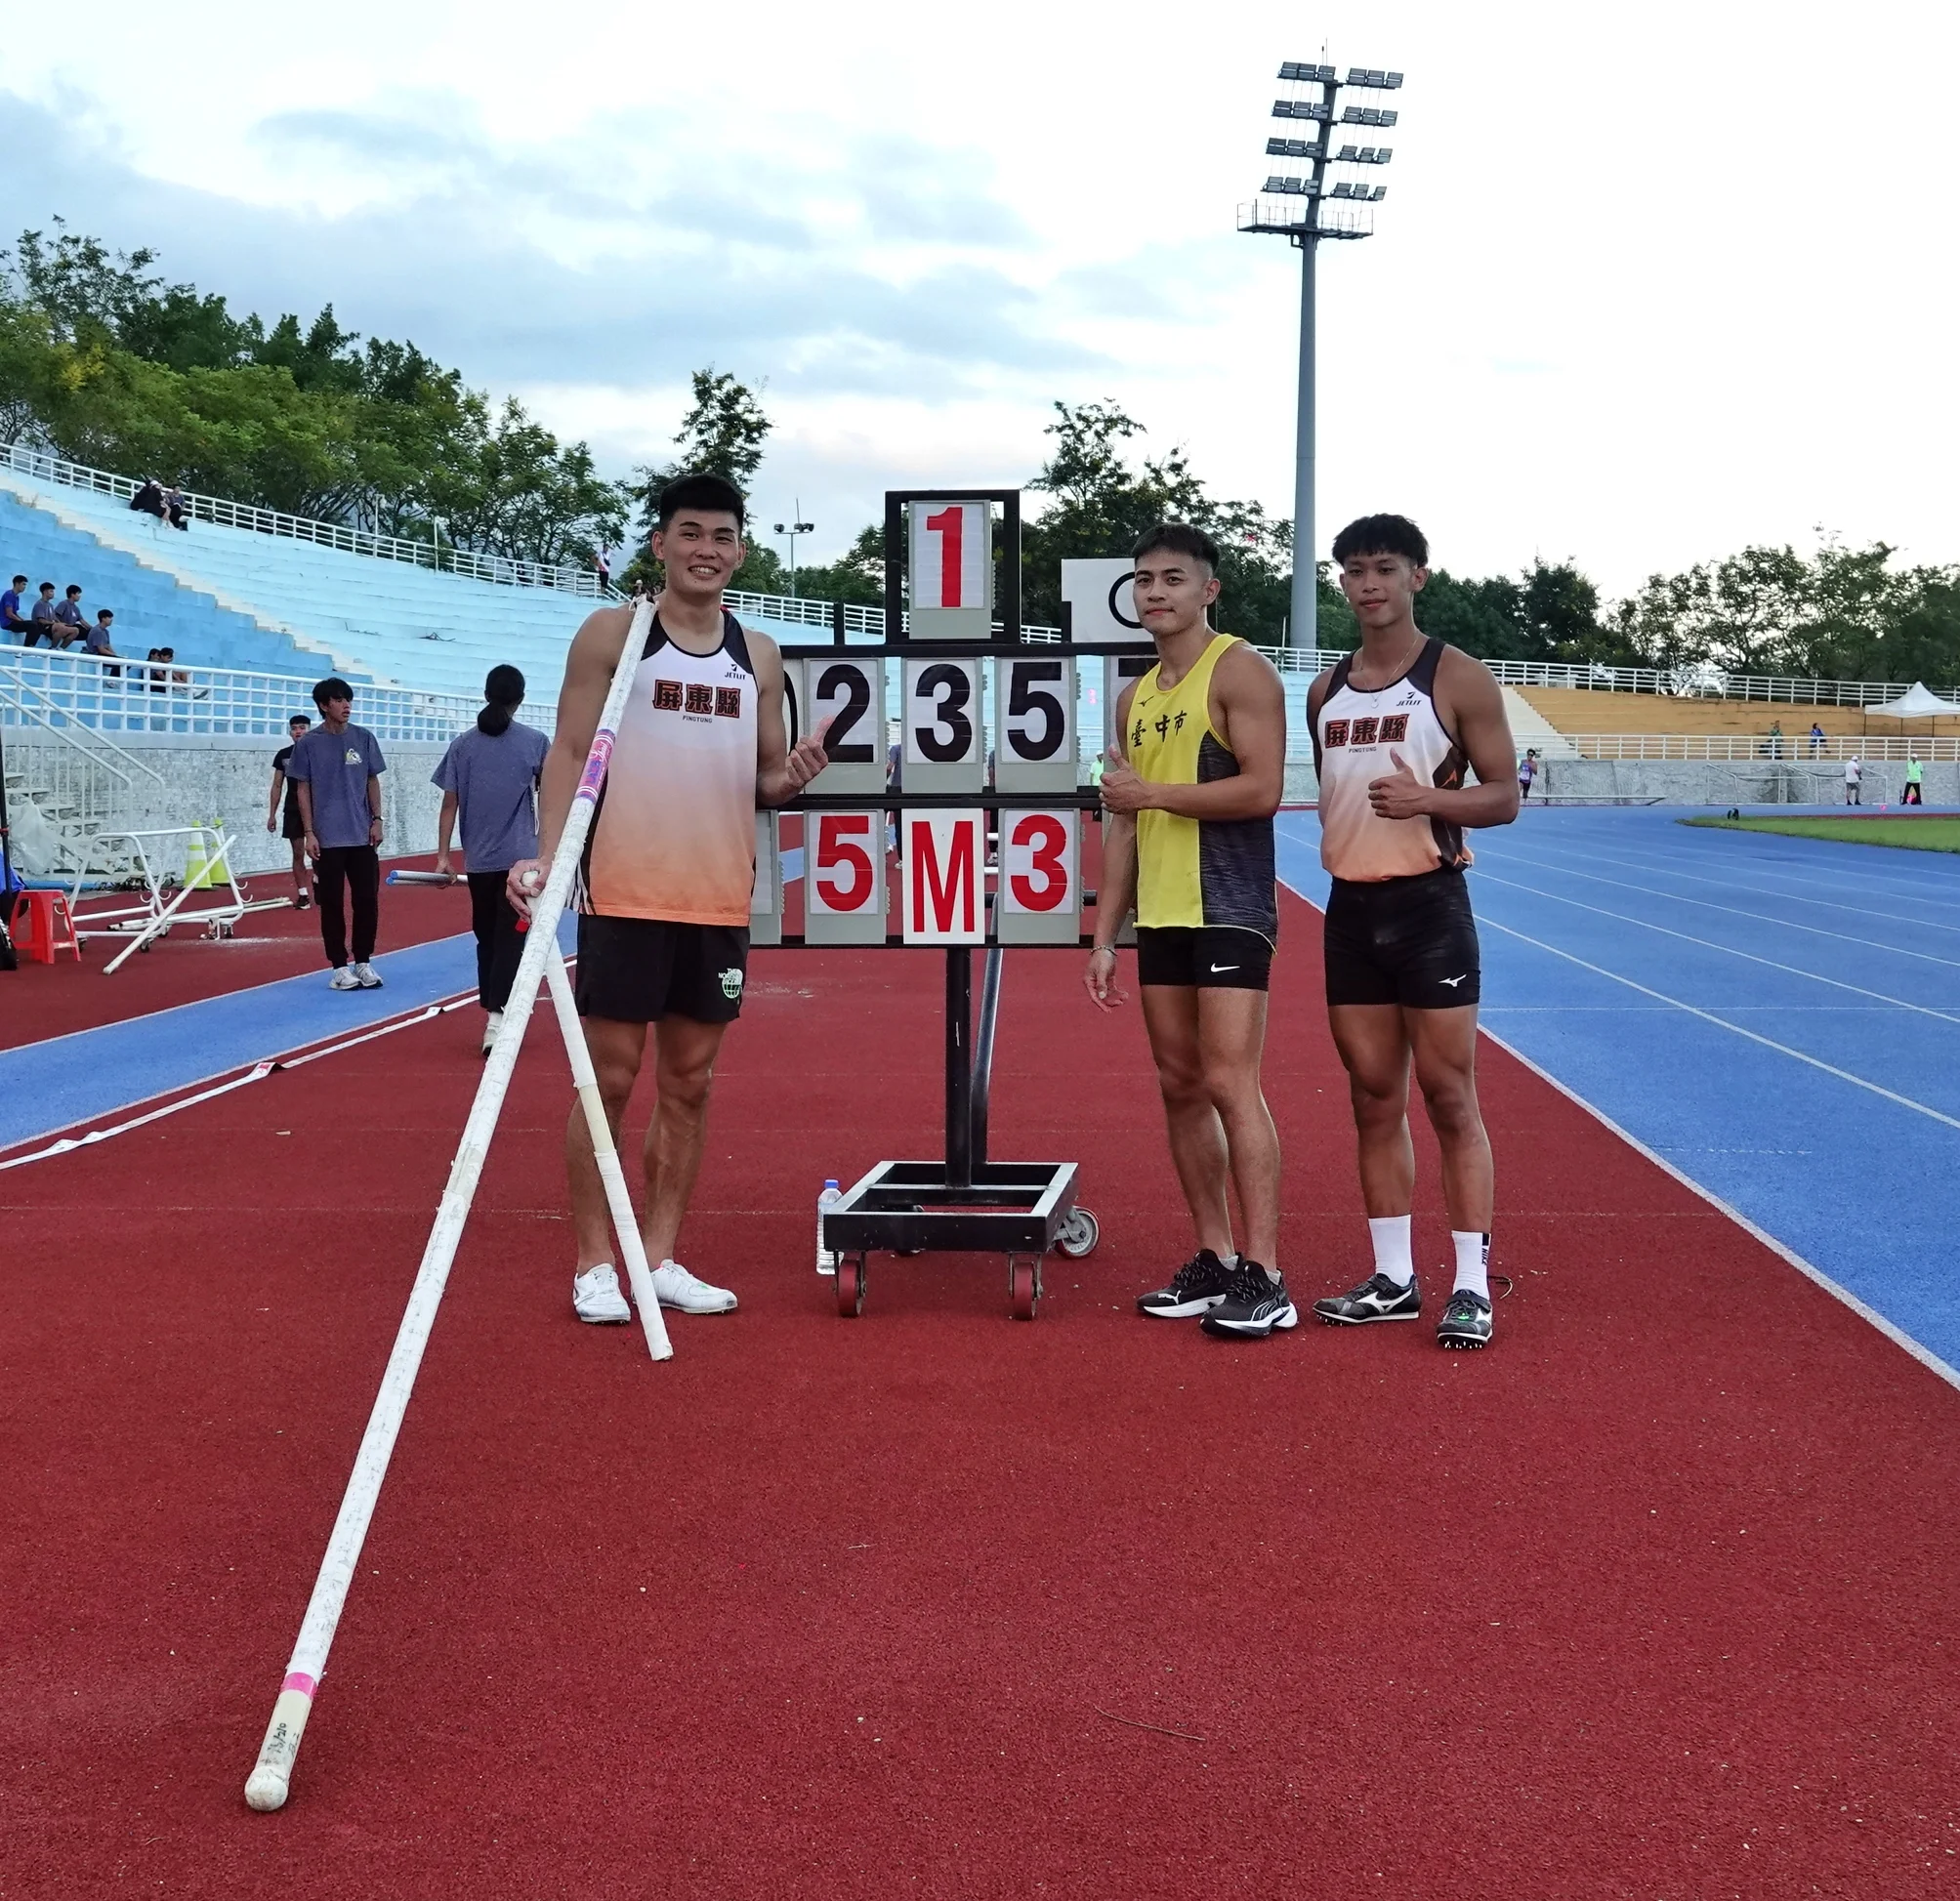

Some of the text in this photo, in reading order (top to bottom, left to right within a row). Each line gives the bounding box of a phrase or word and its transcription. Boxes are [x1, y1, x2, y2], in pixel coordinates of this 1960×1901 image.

[927, 506, 964, 608] 1
[652, 679, 741, 719] 屏東縣
[682, 715, 713, 723] PINGTUNG
[1131, 710, 1188, 748] 臺中市
[1325, 714, 1410, 749] 屏東縣
[816, 814, 1067, 933] 5 M 3
